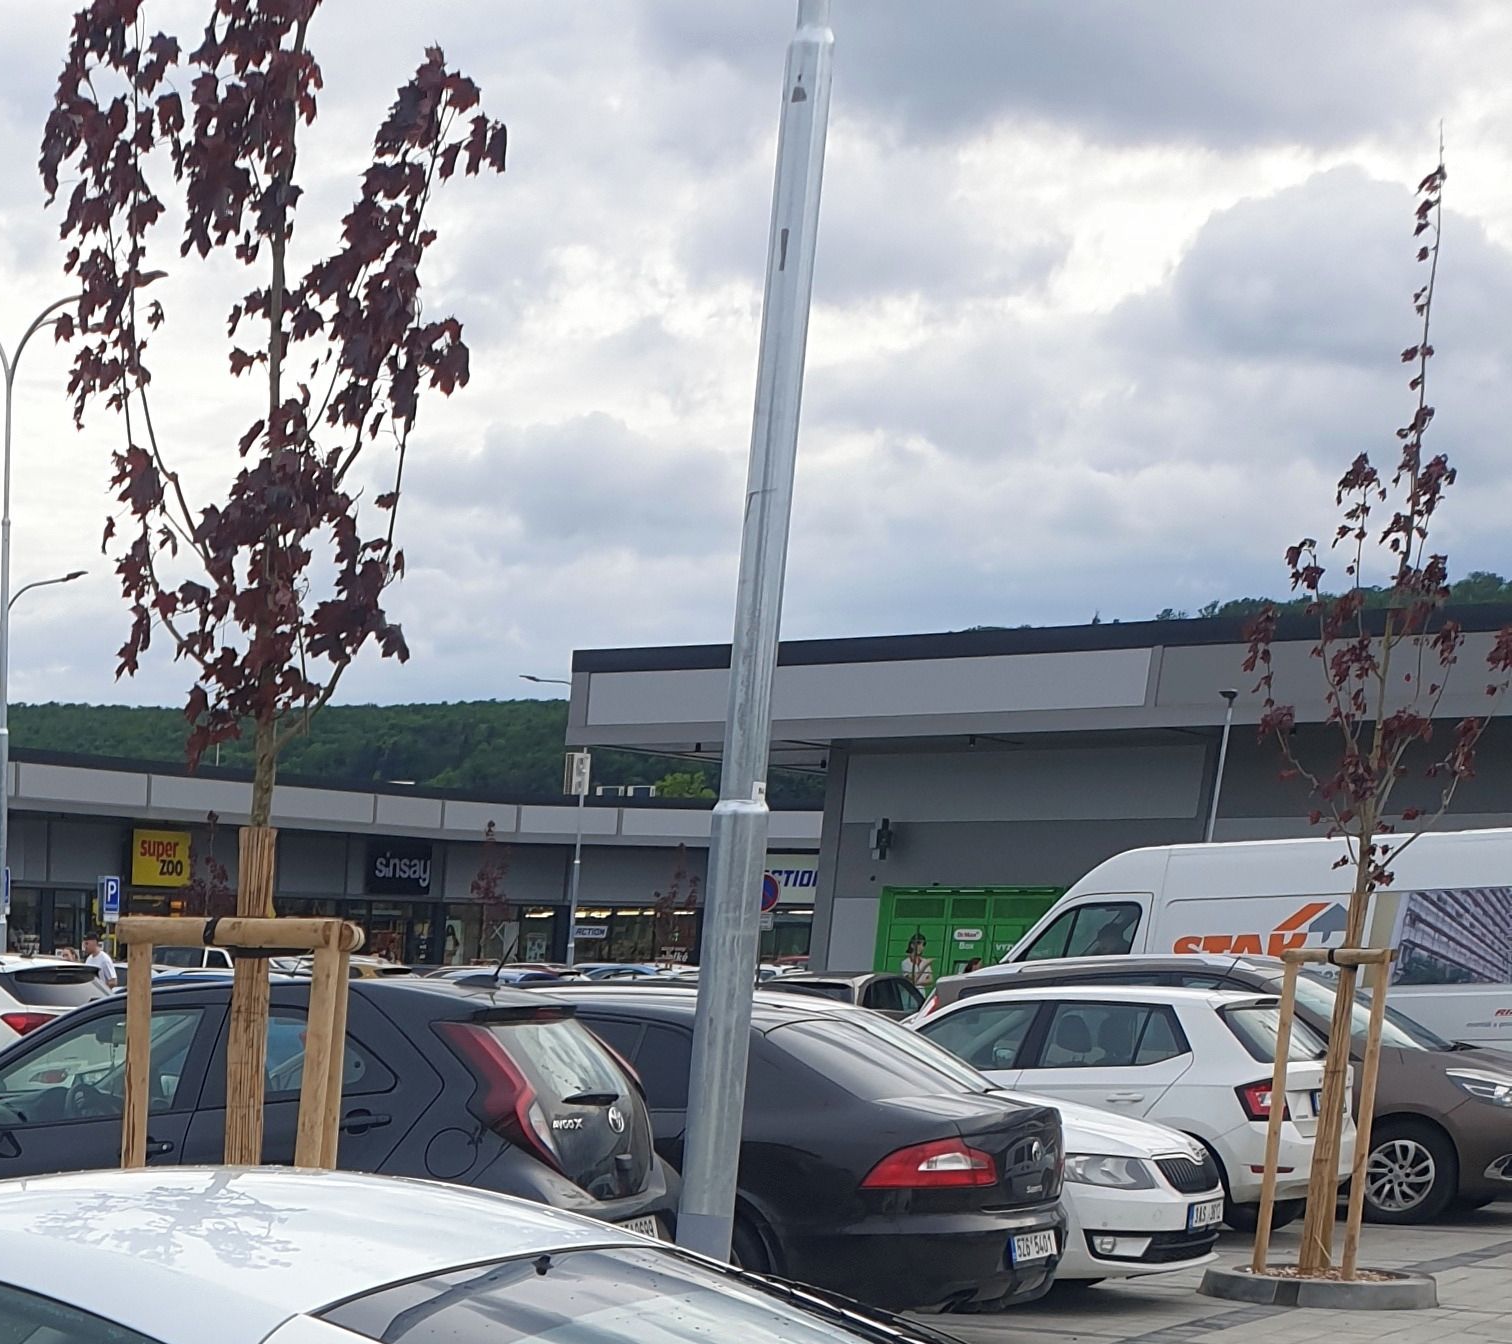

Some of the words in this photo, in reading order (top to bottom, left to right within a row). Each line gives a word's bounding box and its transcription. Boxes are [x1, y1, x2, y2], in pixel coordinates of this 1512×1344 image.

[140, 839, 180, 862] super
[375, 852, 431, 887] sinsay
[108, 881, 117, 902] P
[575, 928, 605, 936] ACTION
[1034, 1233, 1053, 1254] 5401
